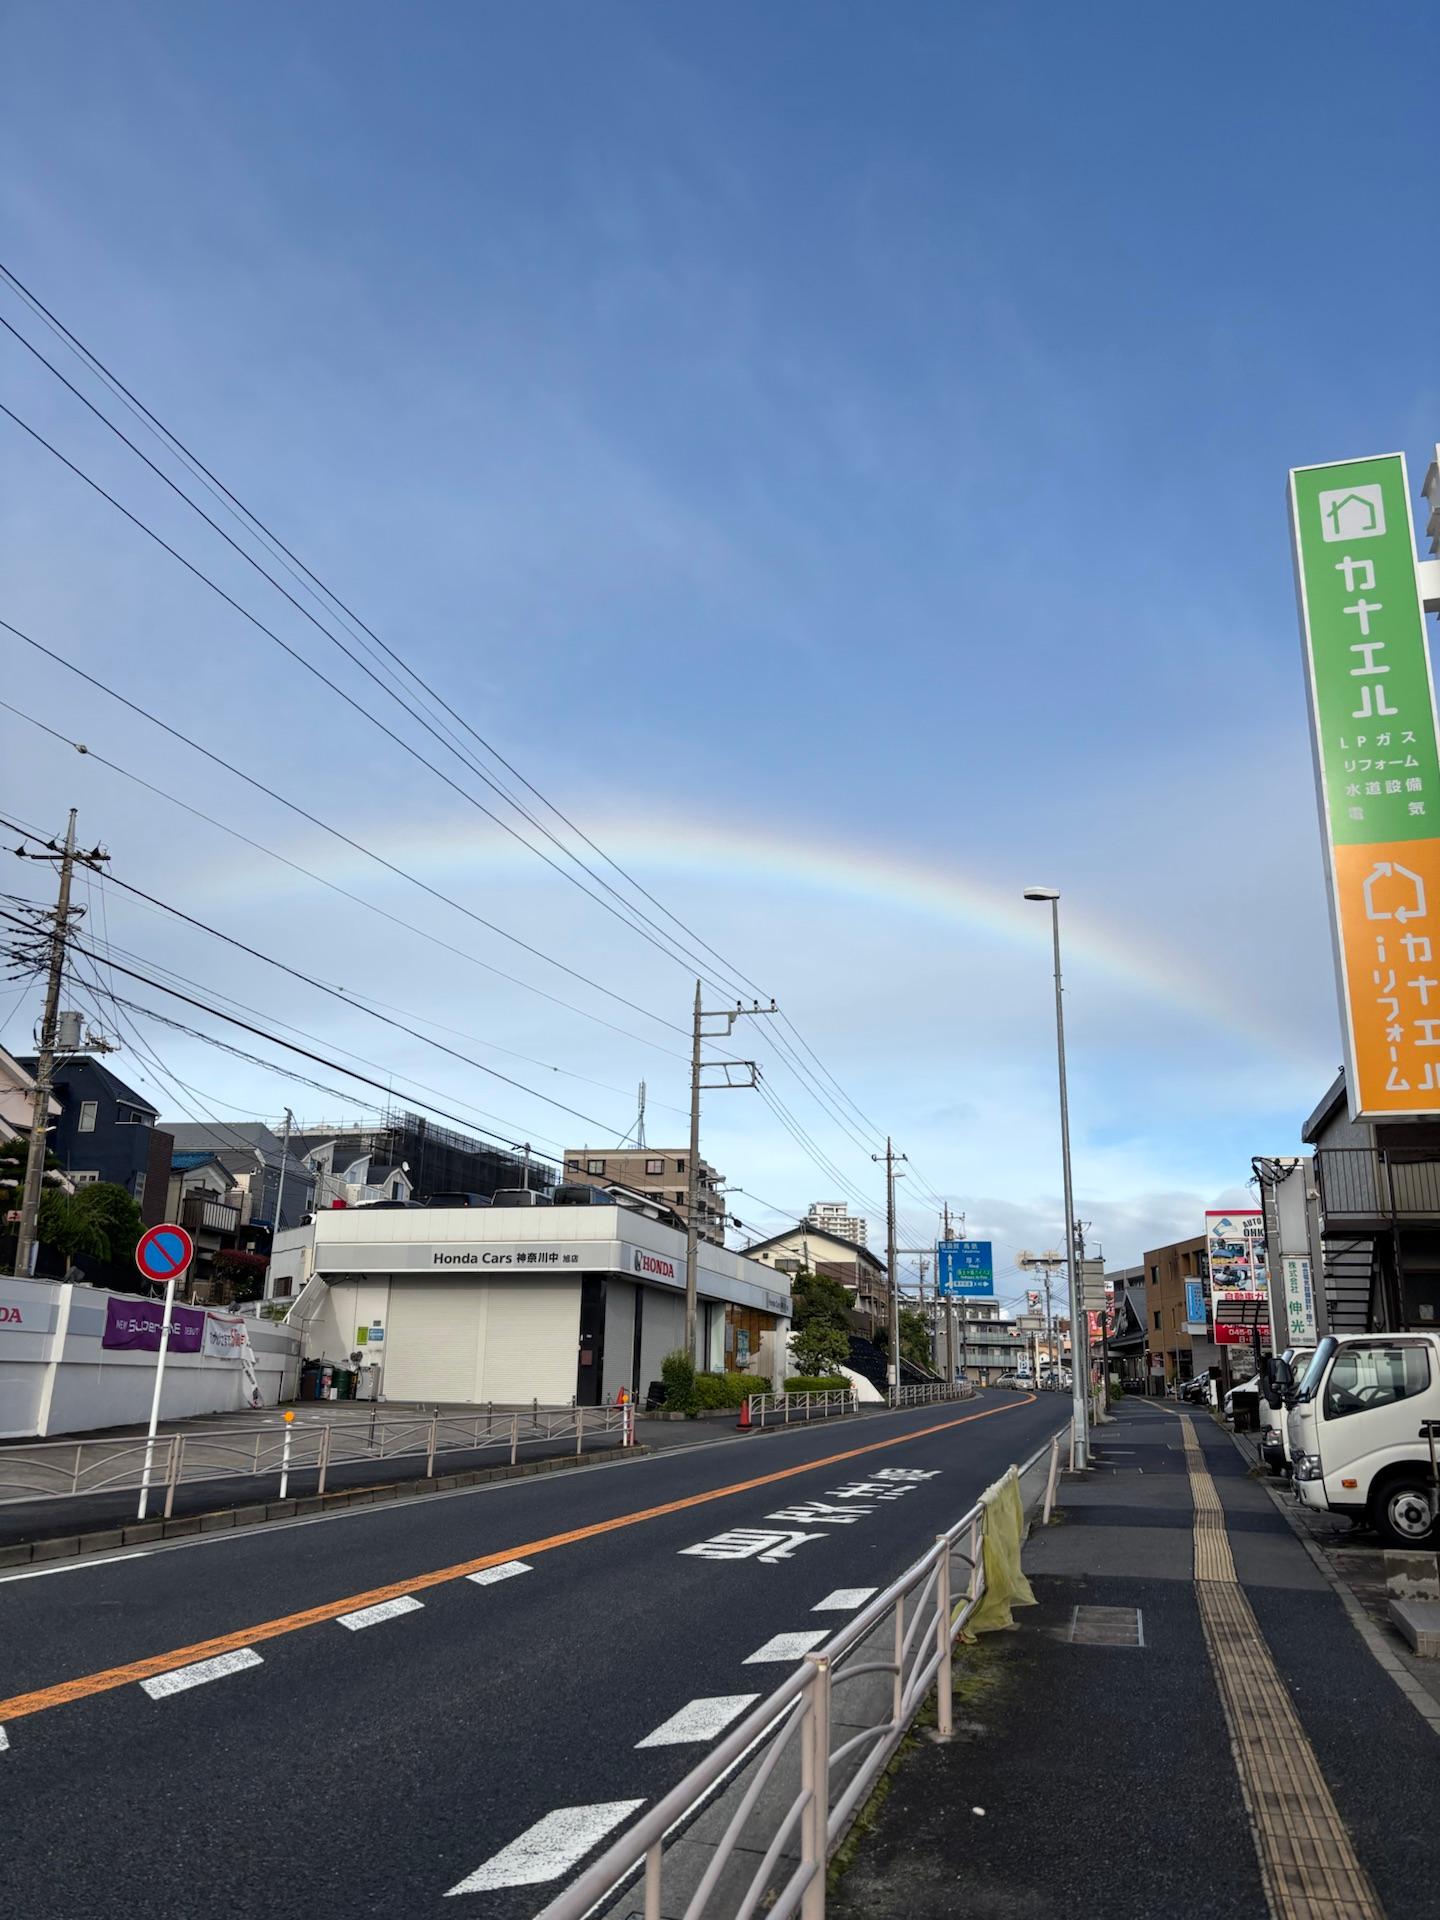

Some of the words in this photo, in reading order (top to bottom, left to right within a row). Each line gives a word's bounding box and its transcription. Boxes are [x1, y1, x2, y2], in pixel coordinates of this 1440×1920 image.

[1335, 556, 1398, 718] カナエル
[1344, 754, 1419, 773] リフォーム
[1345, 777, 1422, 797] 水道設備
[433, 1252, 478, 1264] Honda
[482, 1252, 512, 1264] Cars
[516, 1252, 559, 1263] 神奈川中
[643, 1255, 674, 1278] HONDA
